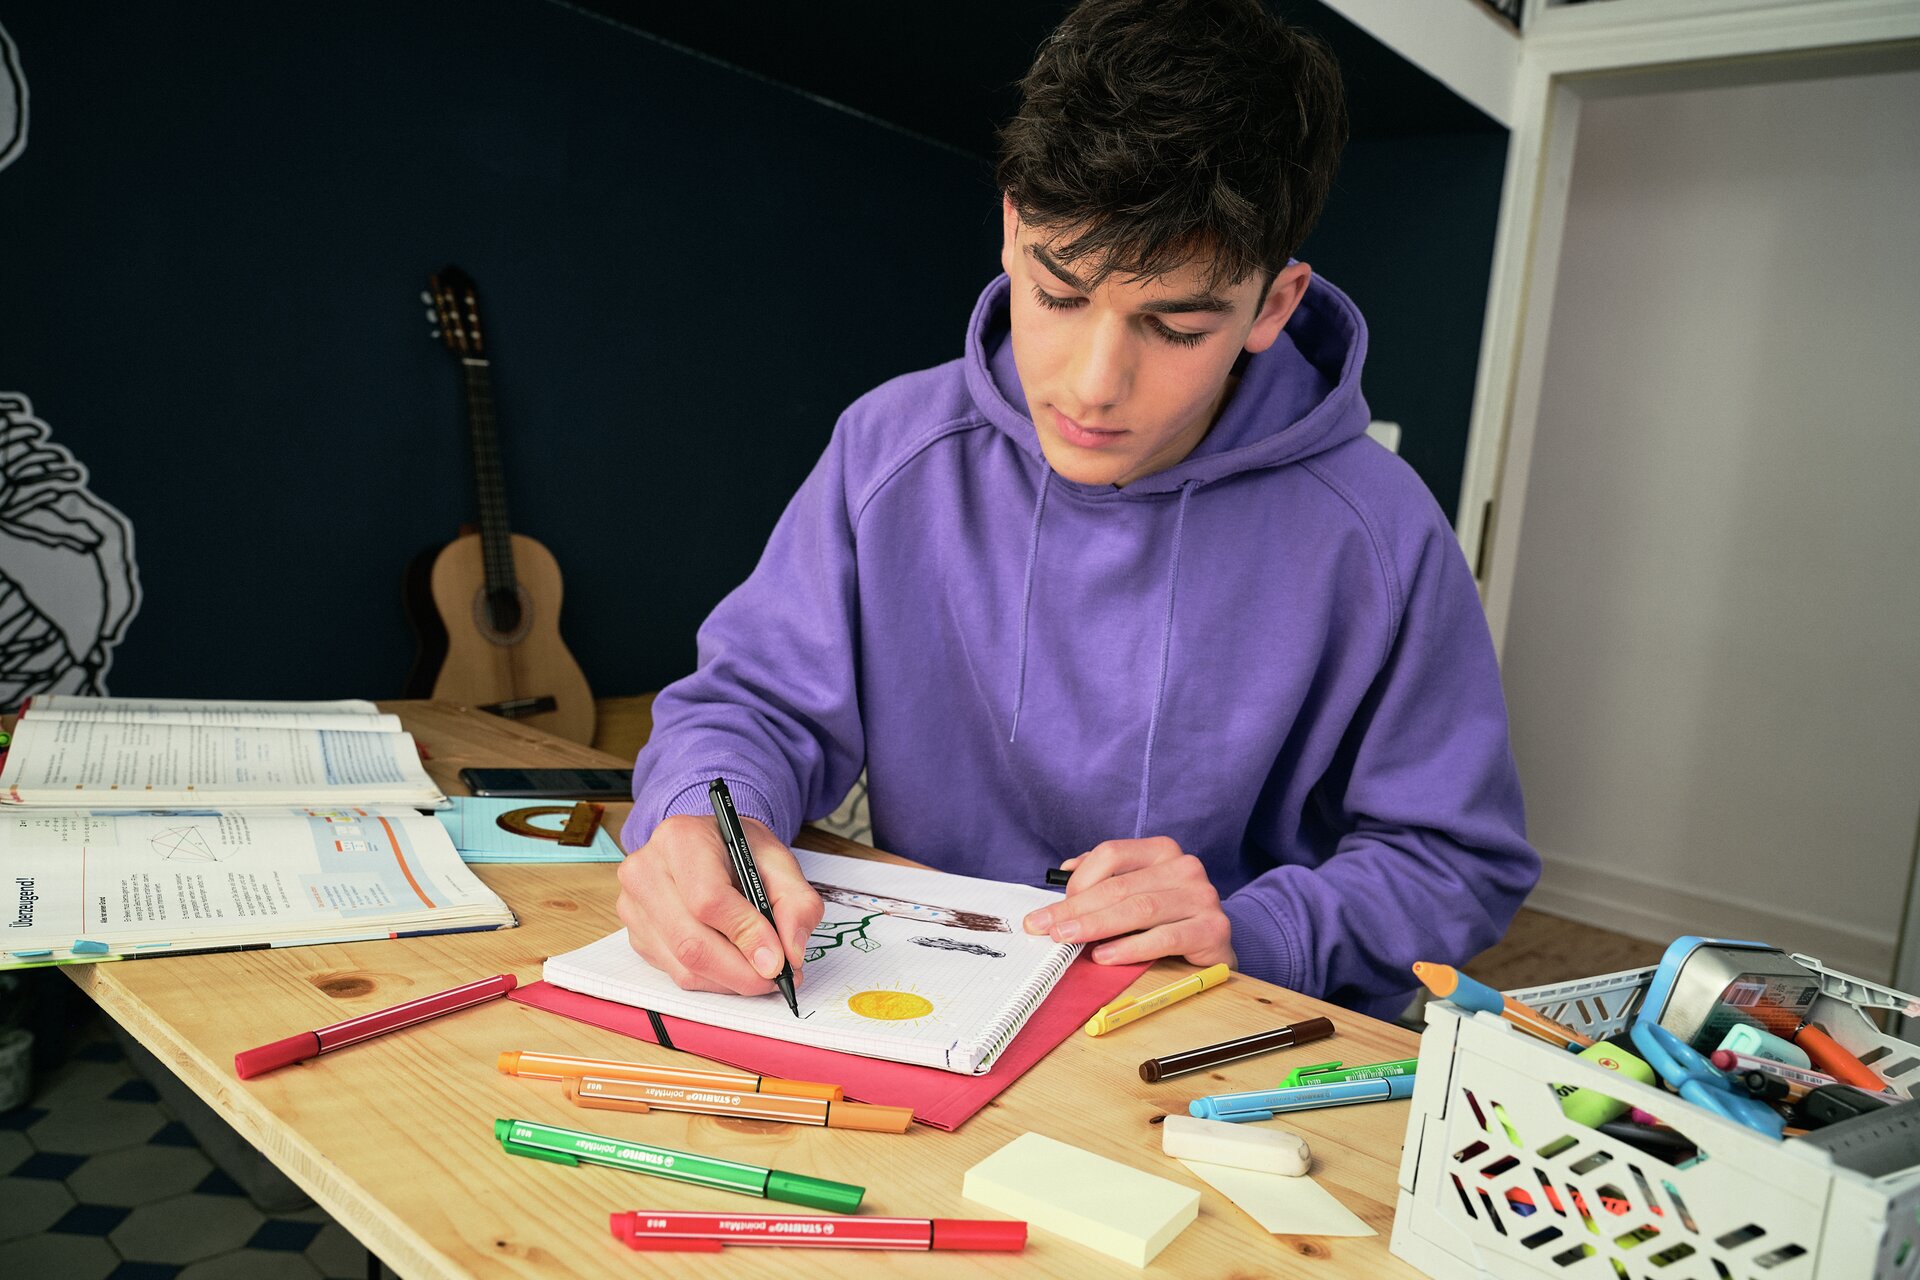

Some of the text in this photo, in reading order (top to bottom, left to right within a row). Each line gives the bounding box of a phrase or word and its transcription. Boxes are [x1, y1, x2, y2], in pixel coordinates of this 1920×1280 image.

[740, 837, 754, 867] pointMax
[8, 877, 39, 928] Überzeugend!
[645, 1087, 685, 1099] pointMax
[574, 1139, 617, 1154] pointMax
[719, 1220, 767, 1232] pointMax
